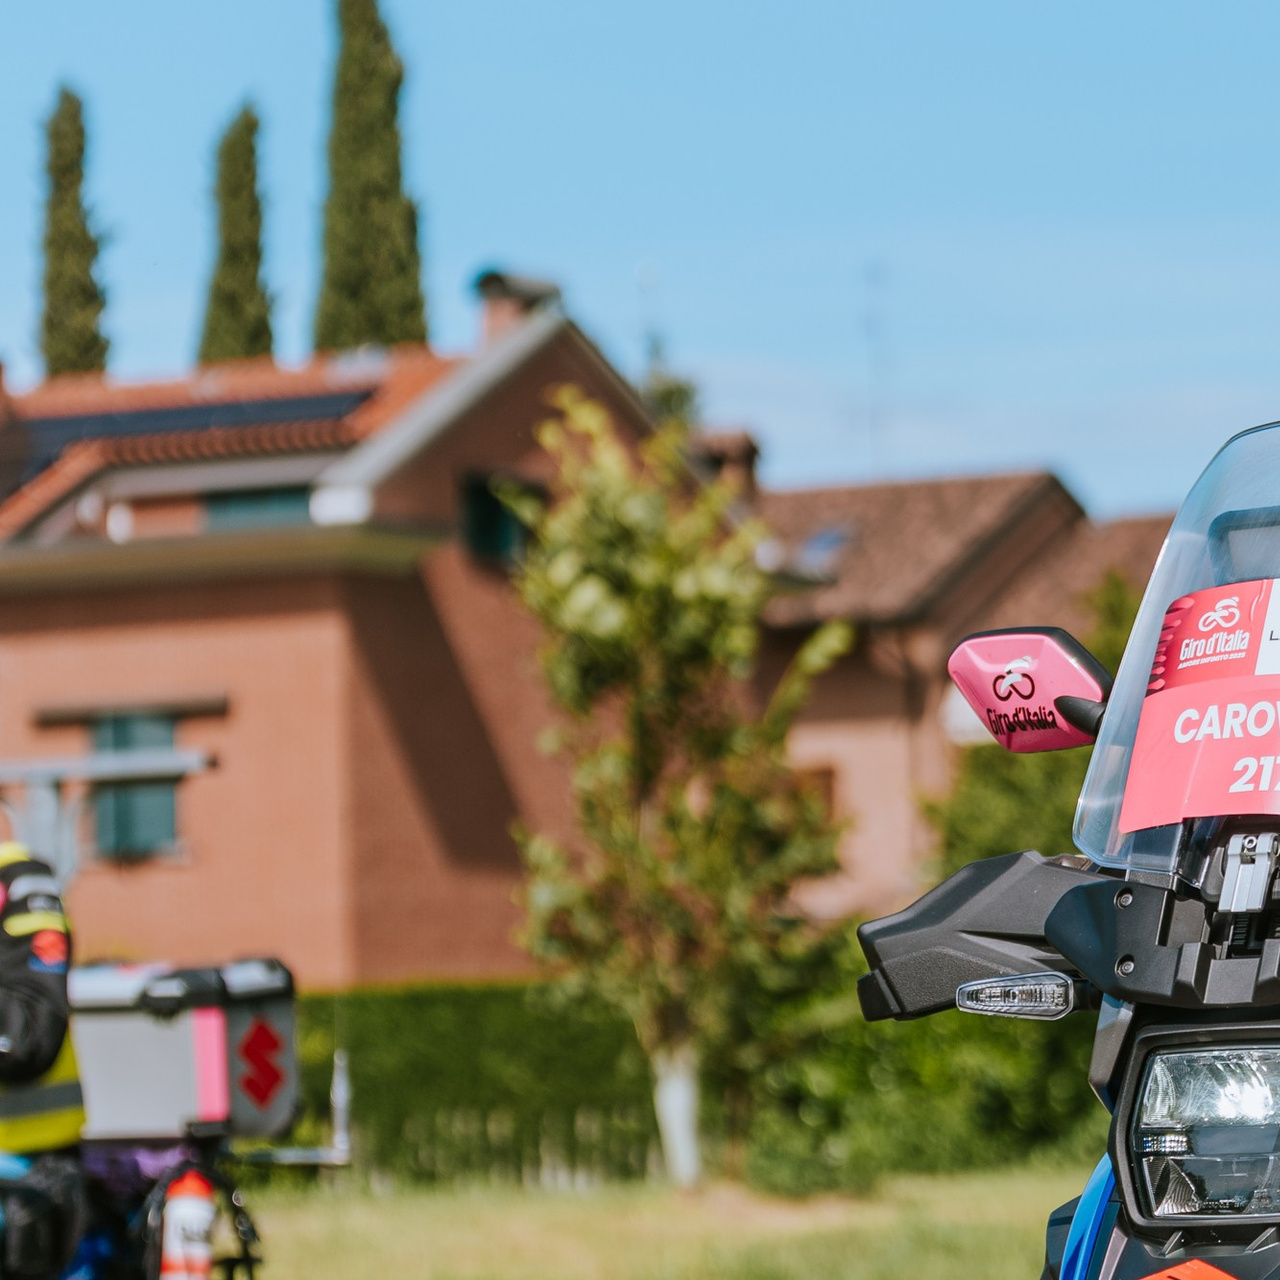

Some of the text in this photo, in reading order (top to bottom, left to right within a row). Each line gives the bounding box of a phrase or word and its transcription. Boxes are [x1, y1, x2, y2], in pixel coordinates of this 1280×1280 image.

[1180, 630, 1250, 661] Giro d'Italia
[986, 708, 1016, 736] Giro
